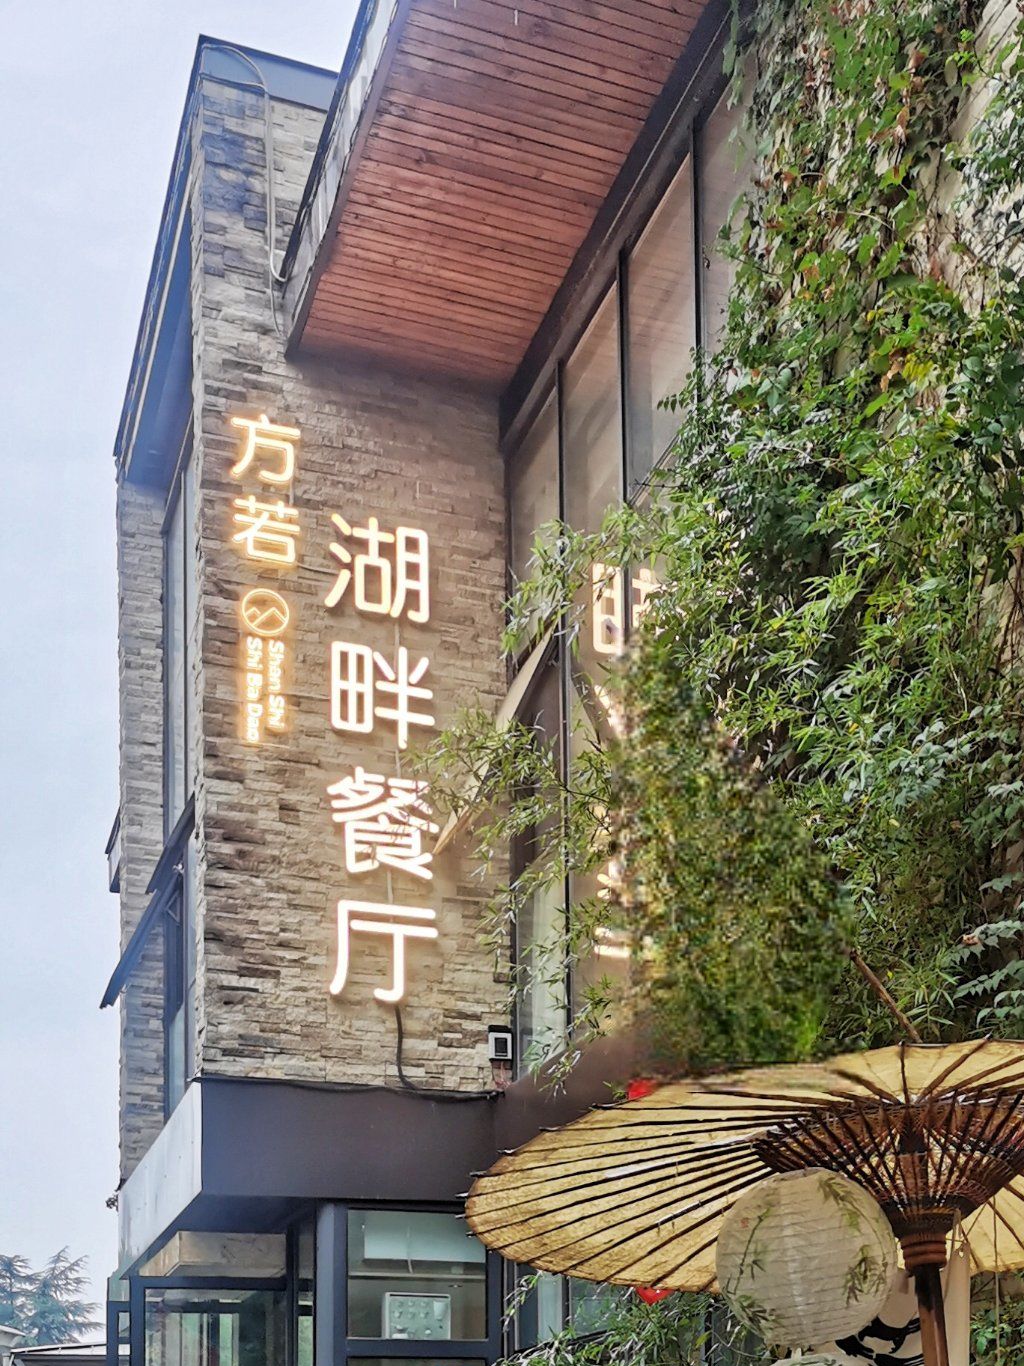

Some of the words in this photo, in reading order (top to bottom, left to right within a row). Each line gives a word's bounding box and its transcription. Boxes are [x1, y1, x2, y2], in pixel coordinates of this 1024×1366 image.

[230, 412, 301, 566] 方若
[323, 510, 440, 1005] 湖畔餐厅
